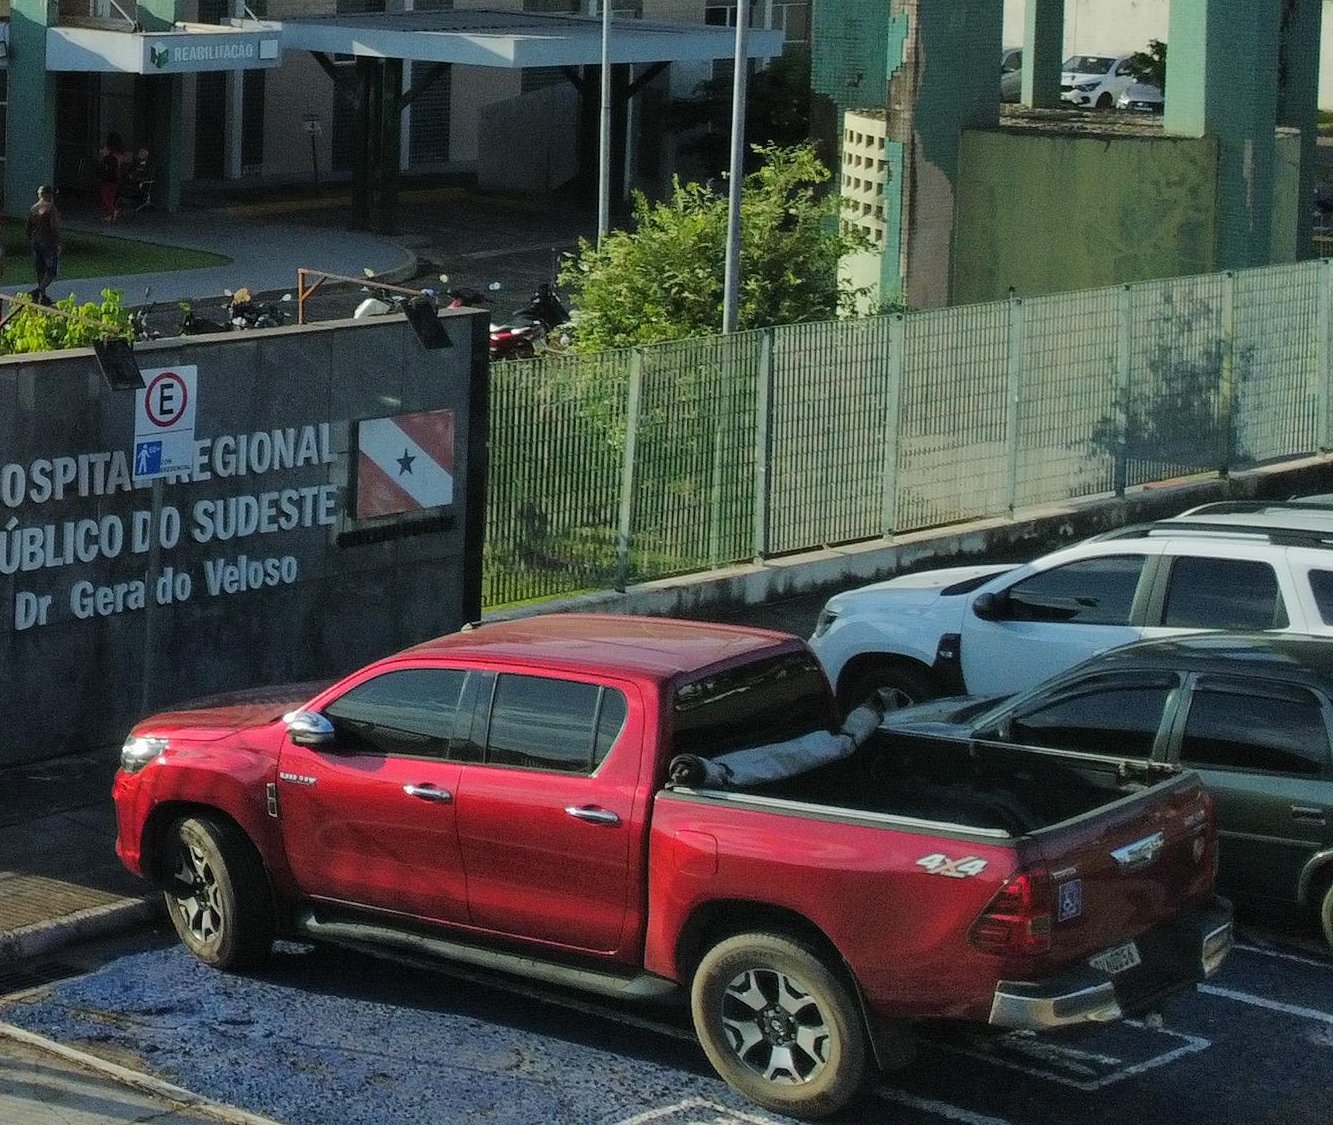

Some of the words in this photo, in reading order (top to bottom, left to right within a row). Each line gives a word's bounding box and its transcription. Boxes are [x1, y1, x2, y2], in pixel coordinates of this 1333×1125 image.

[160, 383, 174, 415] E
[192, 484, 336, 543] SUDESTE
[14, 592, 51, 630] Dr
[203, 555, 298, 596] Veloso
